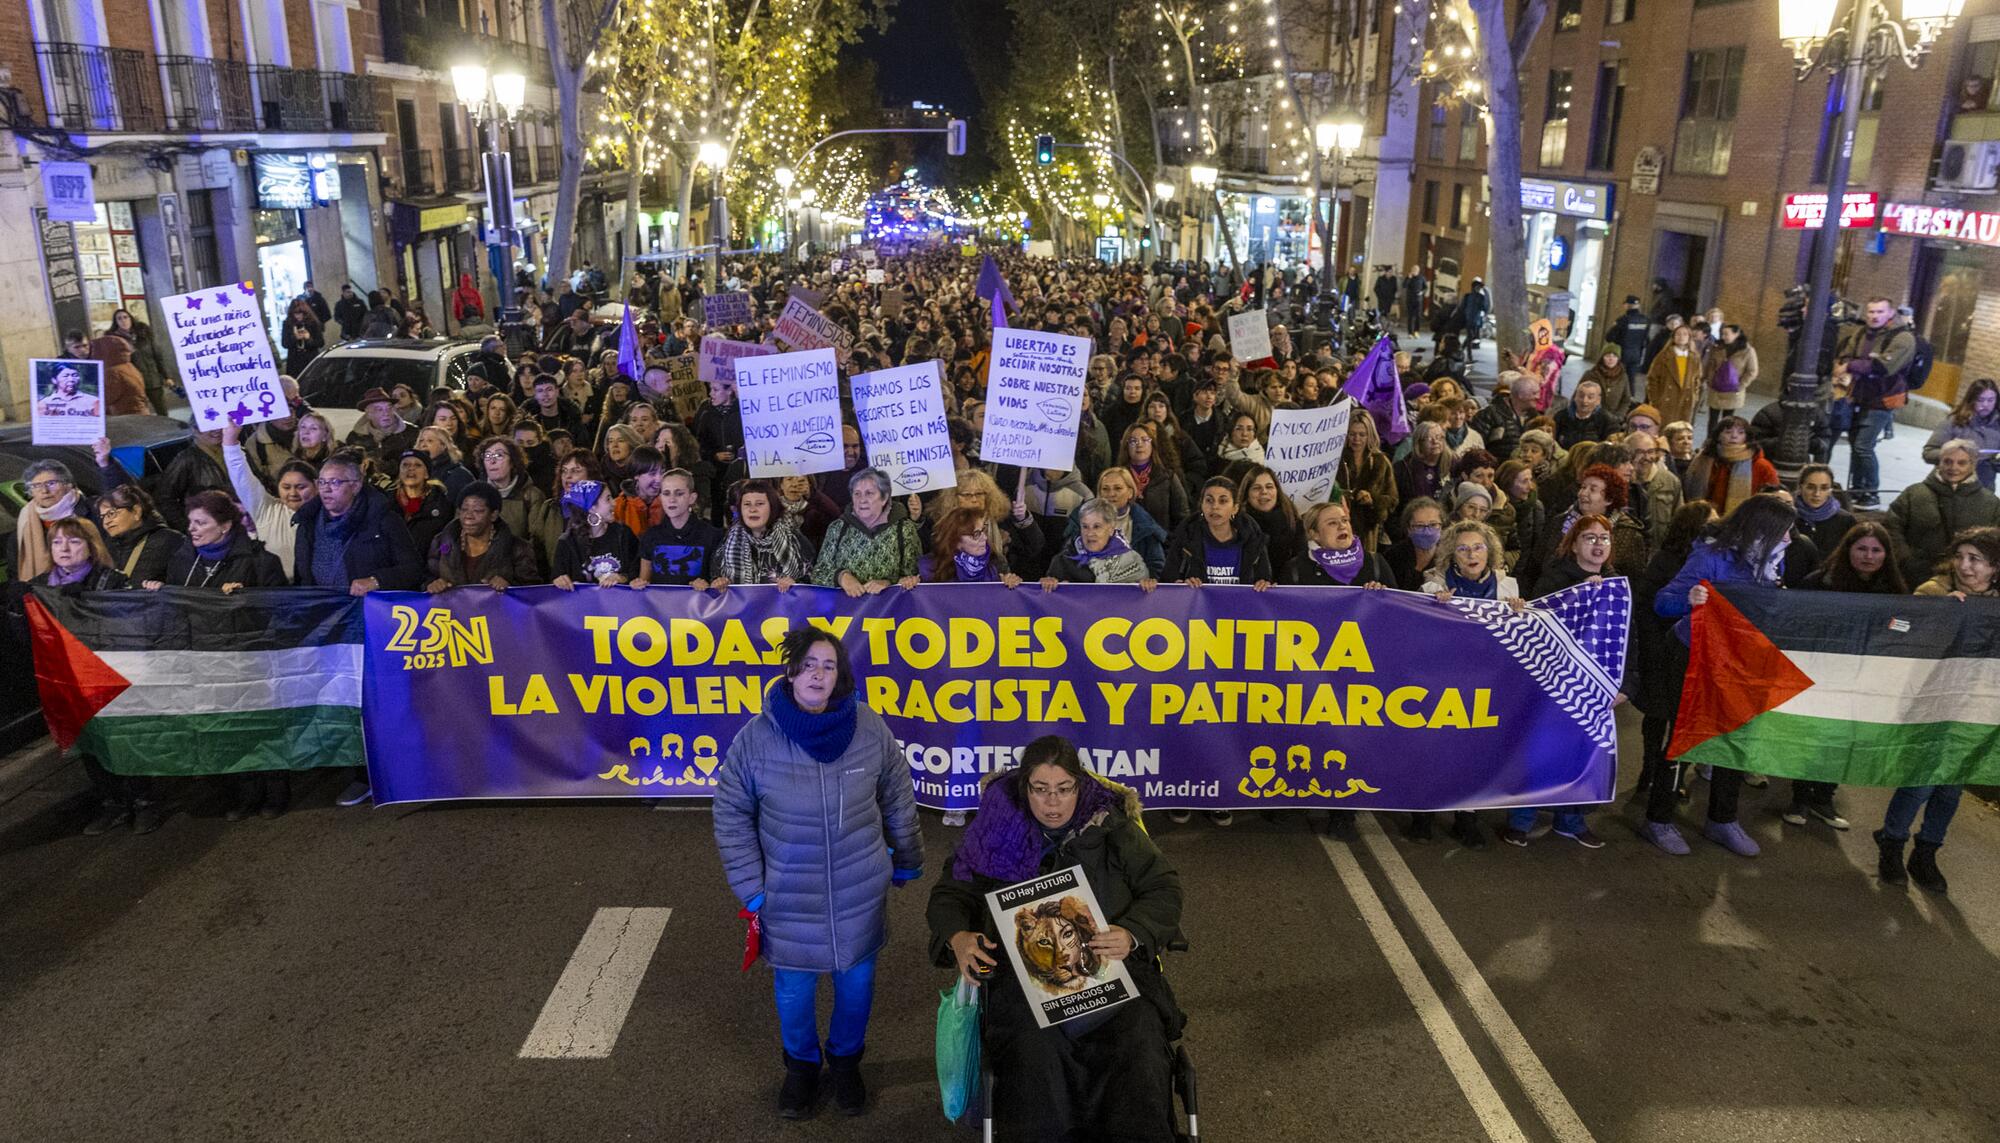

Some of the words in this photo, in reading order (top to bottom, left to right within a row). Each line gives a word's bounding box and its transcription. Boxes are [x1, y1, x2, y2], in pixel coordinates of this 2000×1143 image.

[1786, 203, 1875, 219] VIETAM
[201, 315, 222, 326] una
[224, 309, 252, 322] niña
[787, 300, 853, 349] FEMINISTAS
[180, 324, 237, 348] silenciada
[238, 321, 257, 336] por
[217, 340, 255, 355] tiempo
[1005, 337, 1058, 354] LIBERTAD
[1062, 344, 1077, 356] ES
[738, 370, 758, 387] EL
[762, 360, 834, 385] FEMINISMO
[1000, 357, 1037, 371] DECIDIR
[1038, 361, 1085, 378] NOSOTRAS
[854, 379, 904, 400] PARAMOS
[909, 375, 932, 392] LOS
[999, 376, 1031, 391] SOBRE
[1033, 381, 1081, 397] NUESTRAS
[742, 399, 761, 416] EN
[768, 395, 785, 412] EL
[856, 401, 905, 422] RECORTES
[910, 399, 928, 415] EN
[998, 395, 1029, 410] VIDAS
[744, 424, 780, 440] AYUSO
[780, 422, 789, 436] Y
[790, 415, 835, 436] ALMEIDA
[862, 428, 899, 447] MADRID
[901, 424, 923, 440] CON
[927, 415, 948, 435] MÁS
[985, 430, 1034, 449] ¡MADRID
[749, 450, 759, 466] A
[895, 444, 952, 465] FEMINISTA
[991, 447, 1042, 462] FEMINISTA!
[1266, 446, 1276, 461] A
[1276, 466, 1309, 485] ADRID
[384, 605, 494, 667] 25N
[584, 615, 791, 667] TODAS
[861, 616, 1068, 669] TODES
[1083, 615, 1375, 673] CONTRA
[403, 653, 446, 670] 2025
[489, 674, 560, 716] LA
[567, 673, 786, 717] VIOLEN
[865, 676, 1087, 723] RACISTA
[1096, 681, 1138, 726] Y
[1150, 681, 1500, 729] PATRIARCAL
[892, 740, 1024, 776] CORTES
[1068, 747, 1161, 777] ATAN
[1145, 780, 1220, 798] Madrid
[1001, 891, 1016, 902] NO
[1016, 886, 1035, 898] Hay
[1035, 873, 1073, 892] FUTURO
[1043, 1000, 1060, 1012] SIN
[1060, 986, 1104, 1006] ESPACIOS
[1104, 983, 1116, 992] de
[1063, 996, 1108, 1016] IGUALDAD
